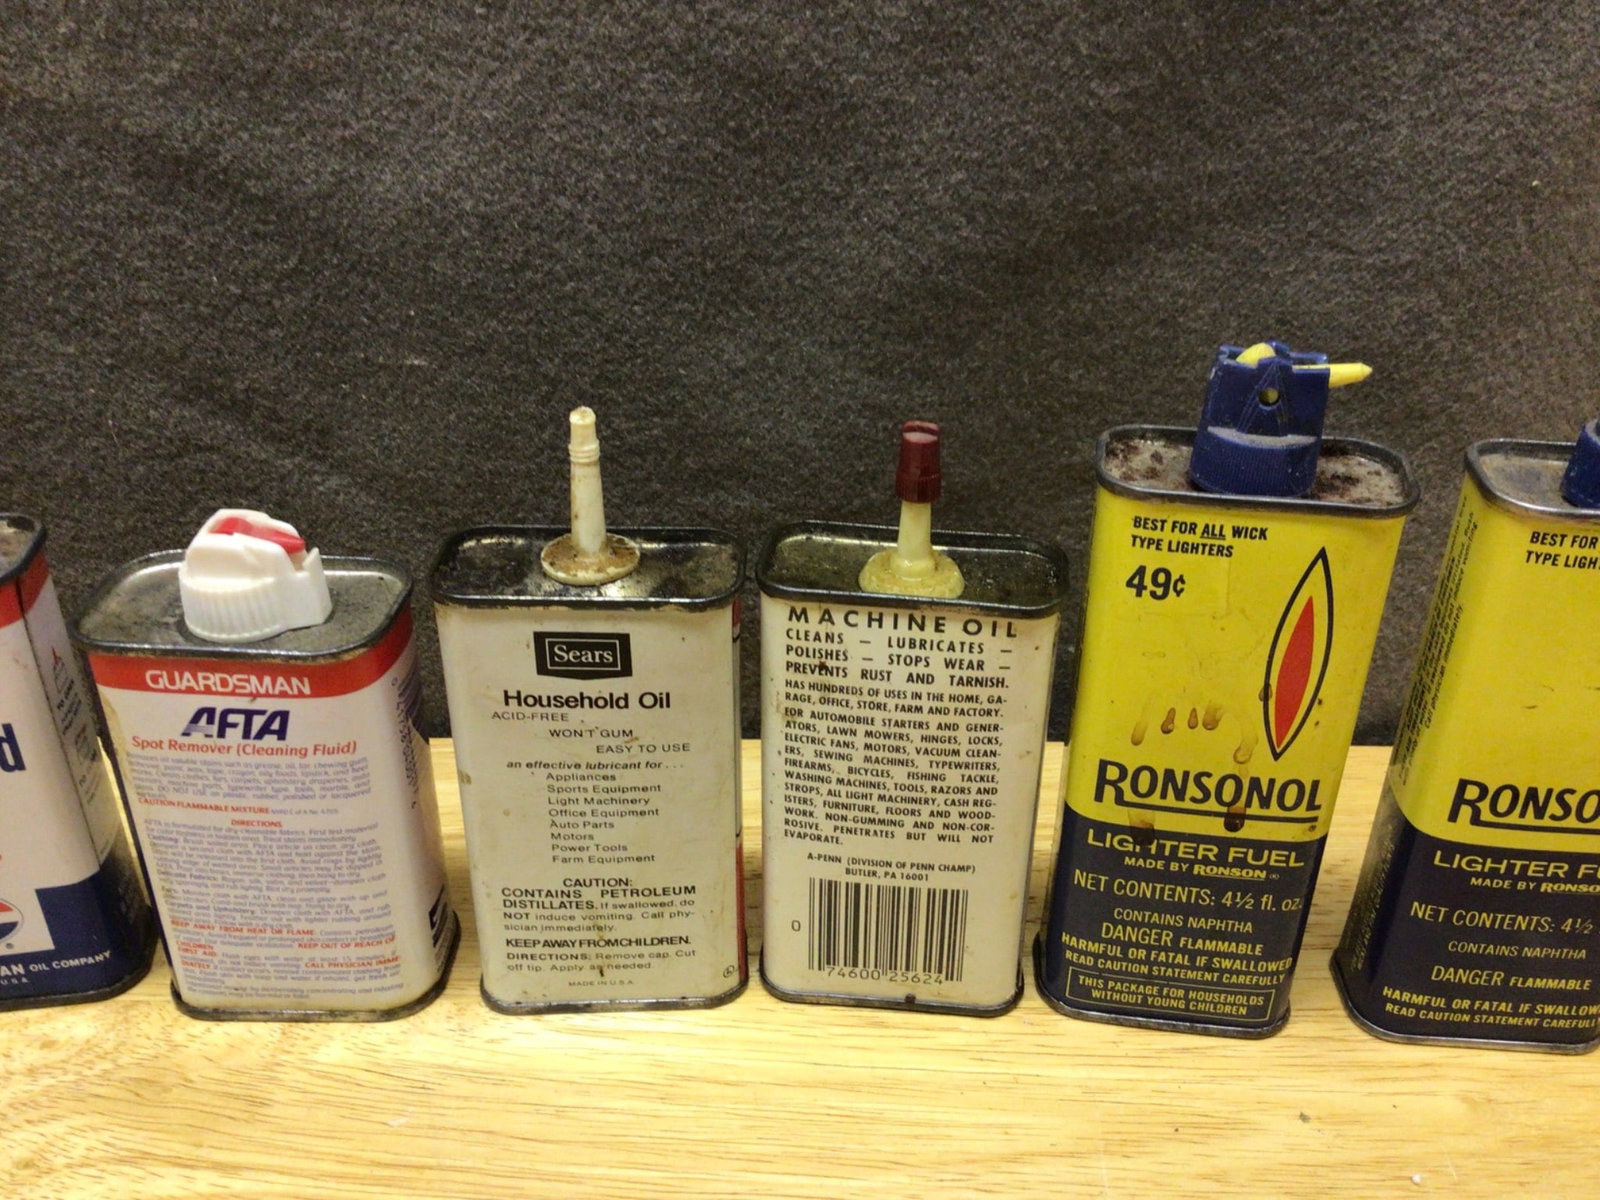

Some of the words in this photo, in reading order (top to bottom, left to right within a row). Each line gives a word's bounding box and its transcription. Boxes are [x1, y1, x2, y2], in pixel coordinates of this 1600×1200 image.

[1134, 516, 1168, 532] BEST
[1171, 520, 1198, 535] FOR
[1202, 523, 1227, 540] ALL
[1232, 526, 1268, 540] WICK
[1132, 534, 1164, 551] TYPE
[1168, 540, 1234, 557] LIGHTERS
[1530, 531, 1568, 547] BEST
[1571, 535, 1599, 549] FOR
[1526, 550, 1561, 566] TYPE
[1564, 555, 1600, 569] LIGH
[1126, 566, 1186, 600] 49¢
[788, 607, 947, 633] MACHINE
[962, 618, 1017, 638] OIL
[786, 628, 844, 644] CLEANS
[888, 637, 984, 654] LUBRICATES
[554, 645, 613, 663] Sears
[786, 644, 849, 661] POLISHES
[888, 654, 930, 668] STOPS
[944, 658, 985, 671] WEAR
[146, 670, 311, 695] GUARDSMAN
[786, 661, 848, 678] PREVENTS
[861, 669, 892, 681] RUST
[906, 672, 935, 684] AND
[950, 675, 1009, 688] TARNISH.
[504, 690, 629, 709] Household
[639, 692, 671, 709] Oil
[785, 679, 805, 690] HAS
[809, 682, 863, 696] HUNDREDS
[868, 688, 880, 697] OF
[884, 689, 907, 699] USES
[911, 691, 923, 700] IN
[927, 692, 944, 702] THE
[949, 694, 983, 704] HOME,
[181, 706, 291, 741] AFTA
[492, 711, 569, 722] ACID-FREE
[600, 729, 633, 738] GUM
[132, 736, 164, 750] Spot
[168, 739, 233, 754] Remover
[237, 744, 308, 759] (Cleaning
[312, 740, 357, 755] Fluid)
[596, 745, 633, 754] EASY
[639, 744, 657, 753] TO
[662, 743, 690, 752] USE
[526, 761, 582, 769] effective
[586, 762, 642, 770] lubricant
[546, 772, 617, 782] Appliances
[547, 784, 589, 794] Sports
[593, 785, 661, 794] Equipment
[1094, 758, 1323, 818] RONSONOL
[138, 798, 176, 808] CAUTION
[176, 801, 229, 812] FLAMMABLE
[230, 806, 271, 815] MIXTURE
[548, 797, 579, 806] Light
[584, 797, 650, 805] Machinery
[1447, 778, 1600, 826] RONSO
[549, 808, 587, 817] Office
[591, 808, 659, 818] Equipment
[230, 819, 283, 829] DIRECTIONS
[550, 819, 580, 829] Auto
[583, 821, 615, 829] Parts
[551, 832, 594, 841] Motors
[784, 829, 844, 845] EVAPORATE.
[552, 844, 590, 852] Power
[594, 844, 628, 852] Tools
[1228, 847, 1304, 867] FUEL
[552, 855, 584, 864] Farm
[588, 855, 655, 864] Equipment
[808, 852, 842, 863] A-PENN
[896, 861, 906, 869] OF
[910, 862, 935, 871] PENN
[1124, 856, 1166, 870] MADE
[1170, 862, 1189, 872] BY
[1193, 864, 1267, 880] RONSON
[1434, 851, 1569, 877] LIGHTER
[563, 878, 632, 888] CAUTION:
[845, 867, 881, 879] BUTLER,
[884, 871, 897, 879] PA
[901, 872, 929, 881] 16001
[1470, 877, 1512, 888] MADE
[1517, 881, 1536, 890] BY
[502, 888, 582, 898] CONTAINS
[601, 886, 696, 898] PETROLEUM
[1074, 869, 1109, 891] NET
[1114, 879, 1215, 906] CONTENTS:
[1261, 894, 1276, 910] fl.
[1114, 908, 1184, 926] CONTAINS
[1188, 917, 1252, 933] NAPHTHA
[1411, 902, 1449, 922] NET
[1453, 910, 1555, 931] CONTENTS:
[506, 938, 541, 948] KEEP
[542, 939, 577, 949] AWAY
[1102, 922, 1174, 946] DANGER
[1180, 937, 1264, 955] FLAMMABLE
[1062, 932, 1123, 957] HARMFUL
[1128, 948, 1147, 960] OR
[1150, 950, 1190, 965] FATAL
[1196, 956, 1209, 967] IF
[1212, 957, 1296, 971] SWALLOWED
[1448, 941, 1519, 956] CONTAINS
[1522, 947, 1586, 959] NAPHTHA
[29, 962, 50, 972] OIL
[52, 950, 111, 970] COMPANY
[1066, 950, 1094, 966] READ
[1098, 959, 1149, 974] CAUTION
[1152, 966, 1220, 981] STATEMENT
[1223, 974, 1285, 985] CAREFULLY
[826, 966, 881, 981] 74600
[888, 970, 943, 985] 25624
[1432, 966, 1505, 986] DANGER
[1510, 977, 1592, 990] FLAMMABLE
[1079, 975, 1104, 988] THIS
[1108, 981, 1160, 995] PACKAGE
[1163, 987, 1185, 998] FOR
[1189, 991, 1264, 1005] HOUSEHOLDS
[1092, 989, 1143, 1003] WITHOUT
[1148, 996, 1186, 1009] YOUNG
[1190, 1000, 1247, 1015] CHILDREN
[1383, 987, 1446, 1008] HARMFUL
[1452, 999, 1471, 1009] OR
[1474, 1000, 1513, 1012] FATAL
[1519, 1003, 1532, 1013] IF
[1535, 1004, 1600, 1016] SWALLOW
[1386, 1003, 1416, 1017] READ
[1419, 1010, 1471, 1022] CAUTION
[1474, 1015, 1540, 1026] STATEMENT
[1543, 1018, 1600, 1028] CAREFULL
